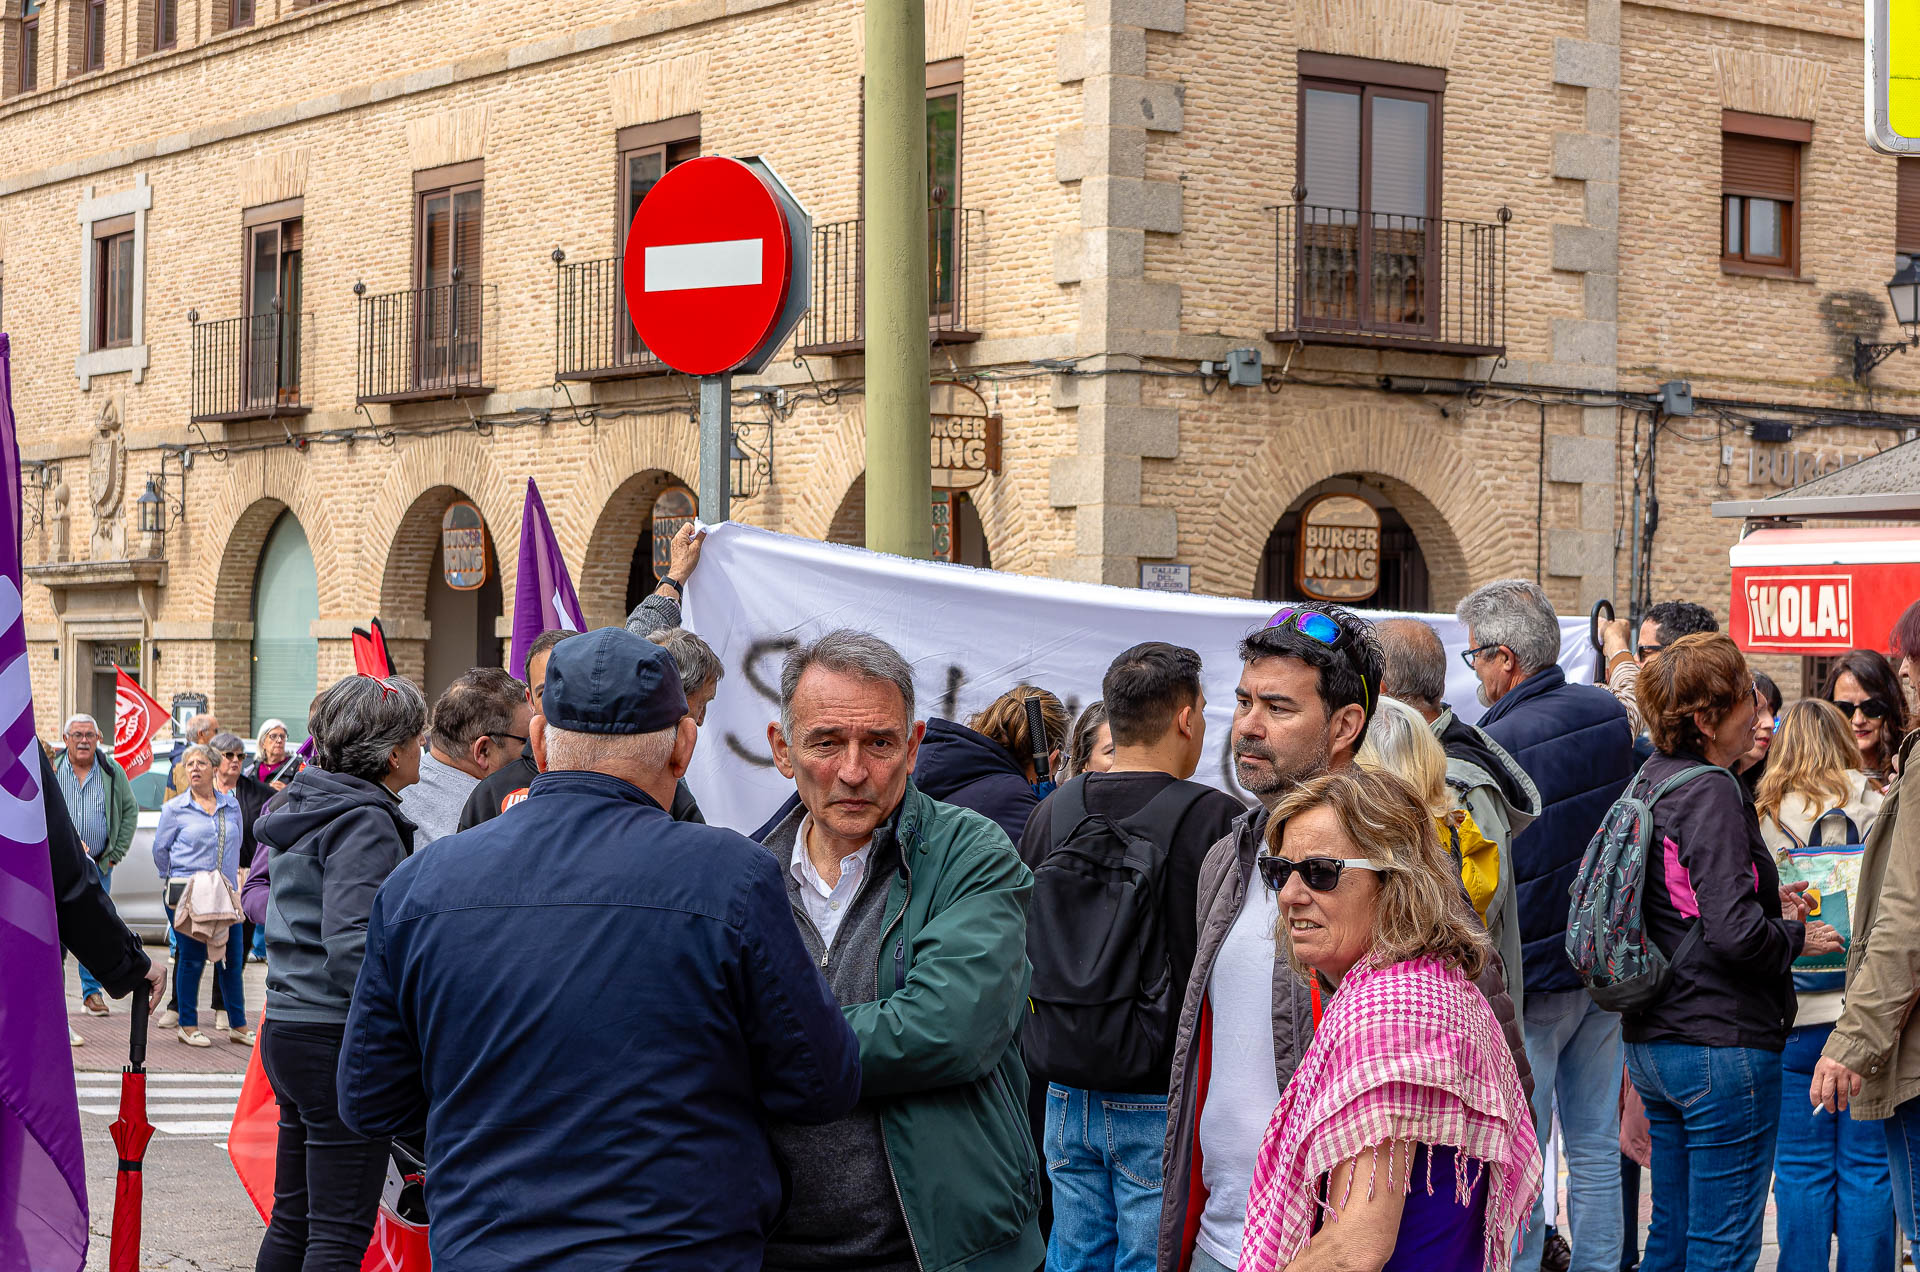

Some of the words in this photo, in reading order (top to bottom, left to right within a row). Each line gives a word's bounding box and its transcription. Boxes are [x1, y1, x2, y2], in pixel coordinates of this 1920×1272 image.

[931, 417, 986, 439] RGER
[931, 437, 986, 469] ING
[1749, 448, 1862, 487] BURG
[1306, 526, 1378, 549] BURGER
[1151, 567, 1181, 575] CALLE
[1304, 548, 1377, 579] KING
[1749, 585, 1849, 638] ¡HOLA!
